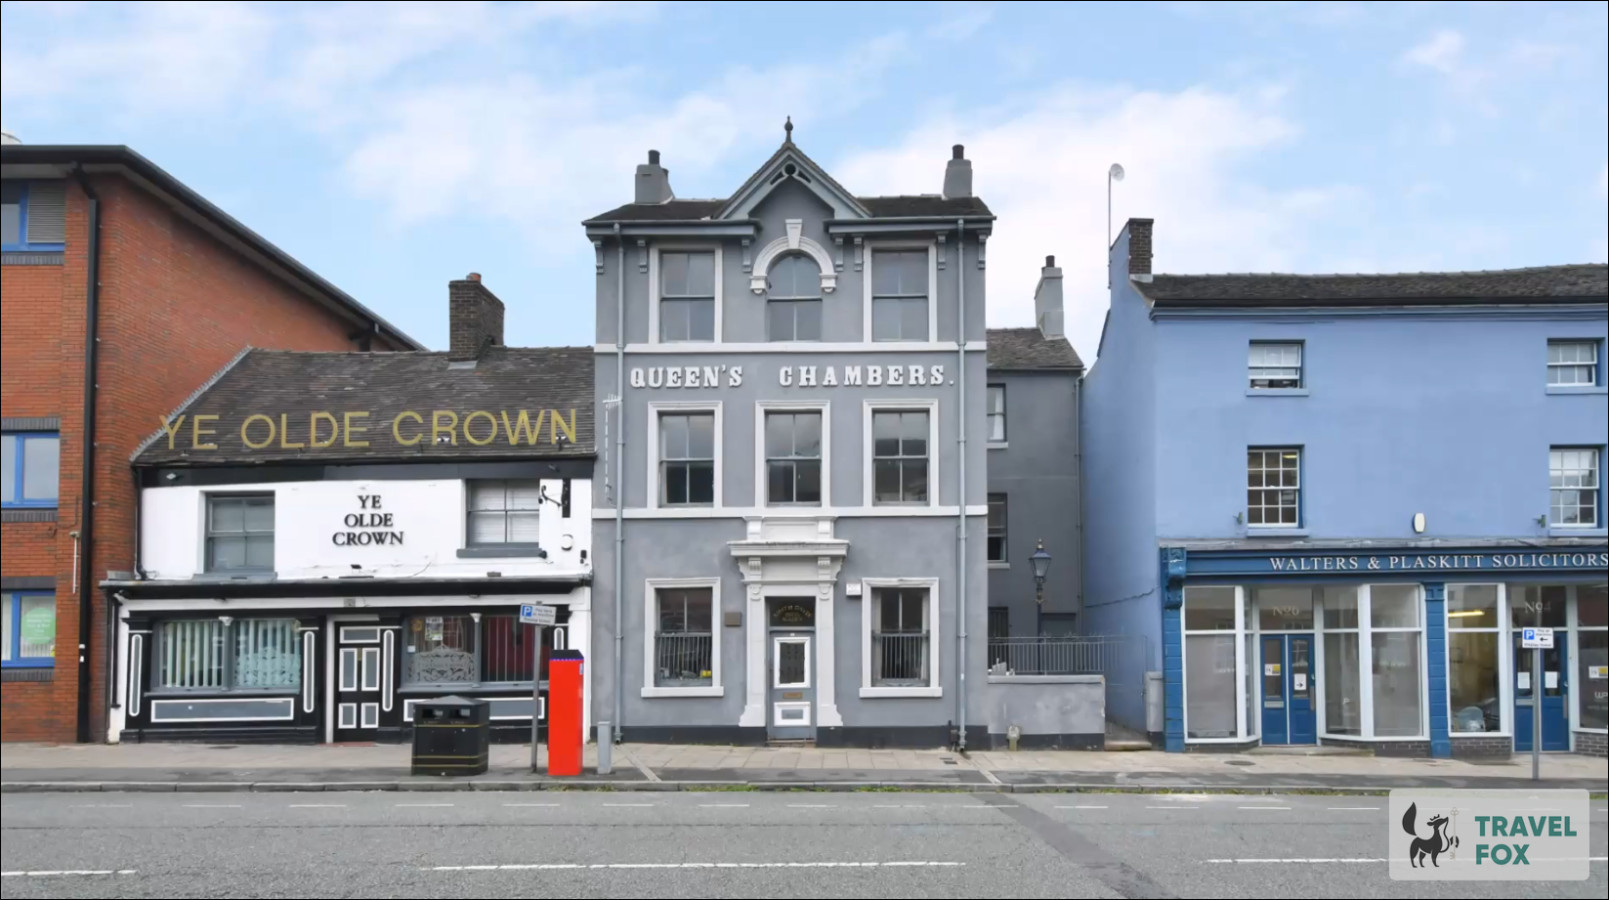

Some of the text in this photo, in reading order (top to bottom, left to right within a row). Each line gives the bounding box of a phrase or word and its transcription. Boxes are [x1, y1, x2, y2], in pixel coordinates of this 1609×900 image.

[630, 364, 955, 389] QUEEN'S CHAMBERS.
[159, 408, 577, 450] YE OLDE CROWN
[358, 495, 382, 509] YE
[344, 513, 393, 528] OLDE
[332, 530, 403, 546] CROWN
[1270, 553, 1608, 571] WALTERS & PLASKITT SOLICITORS
